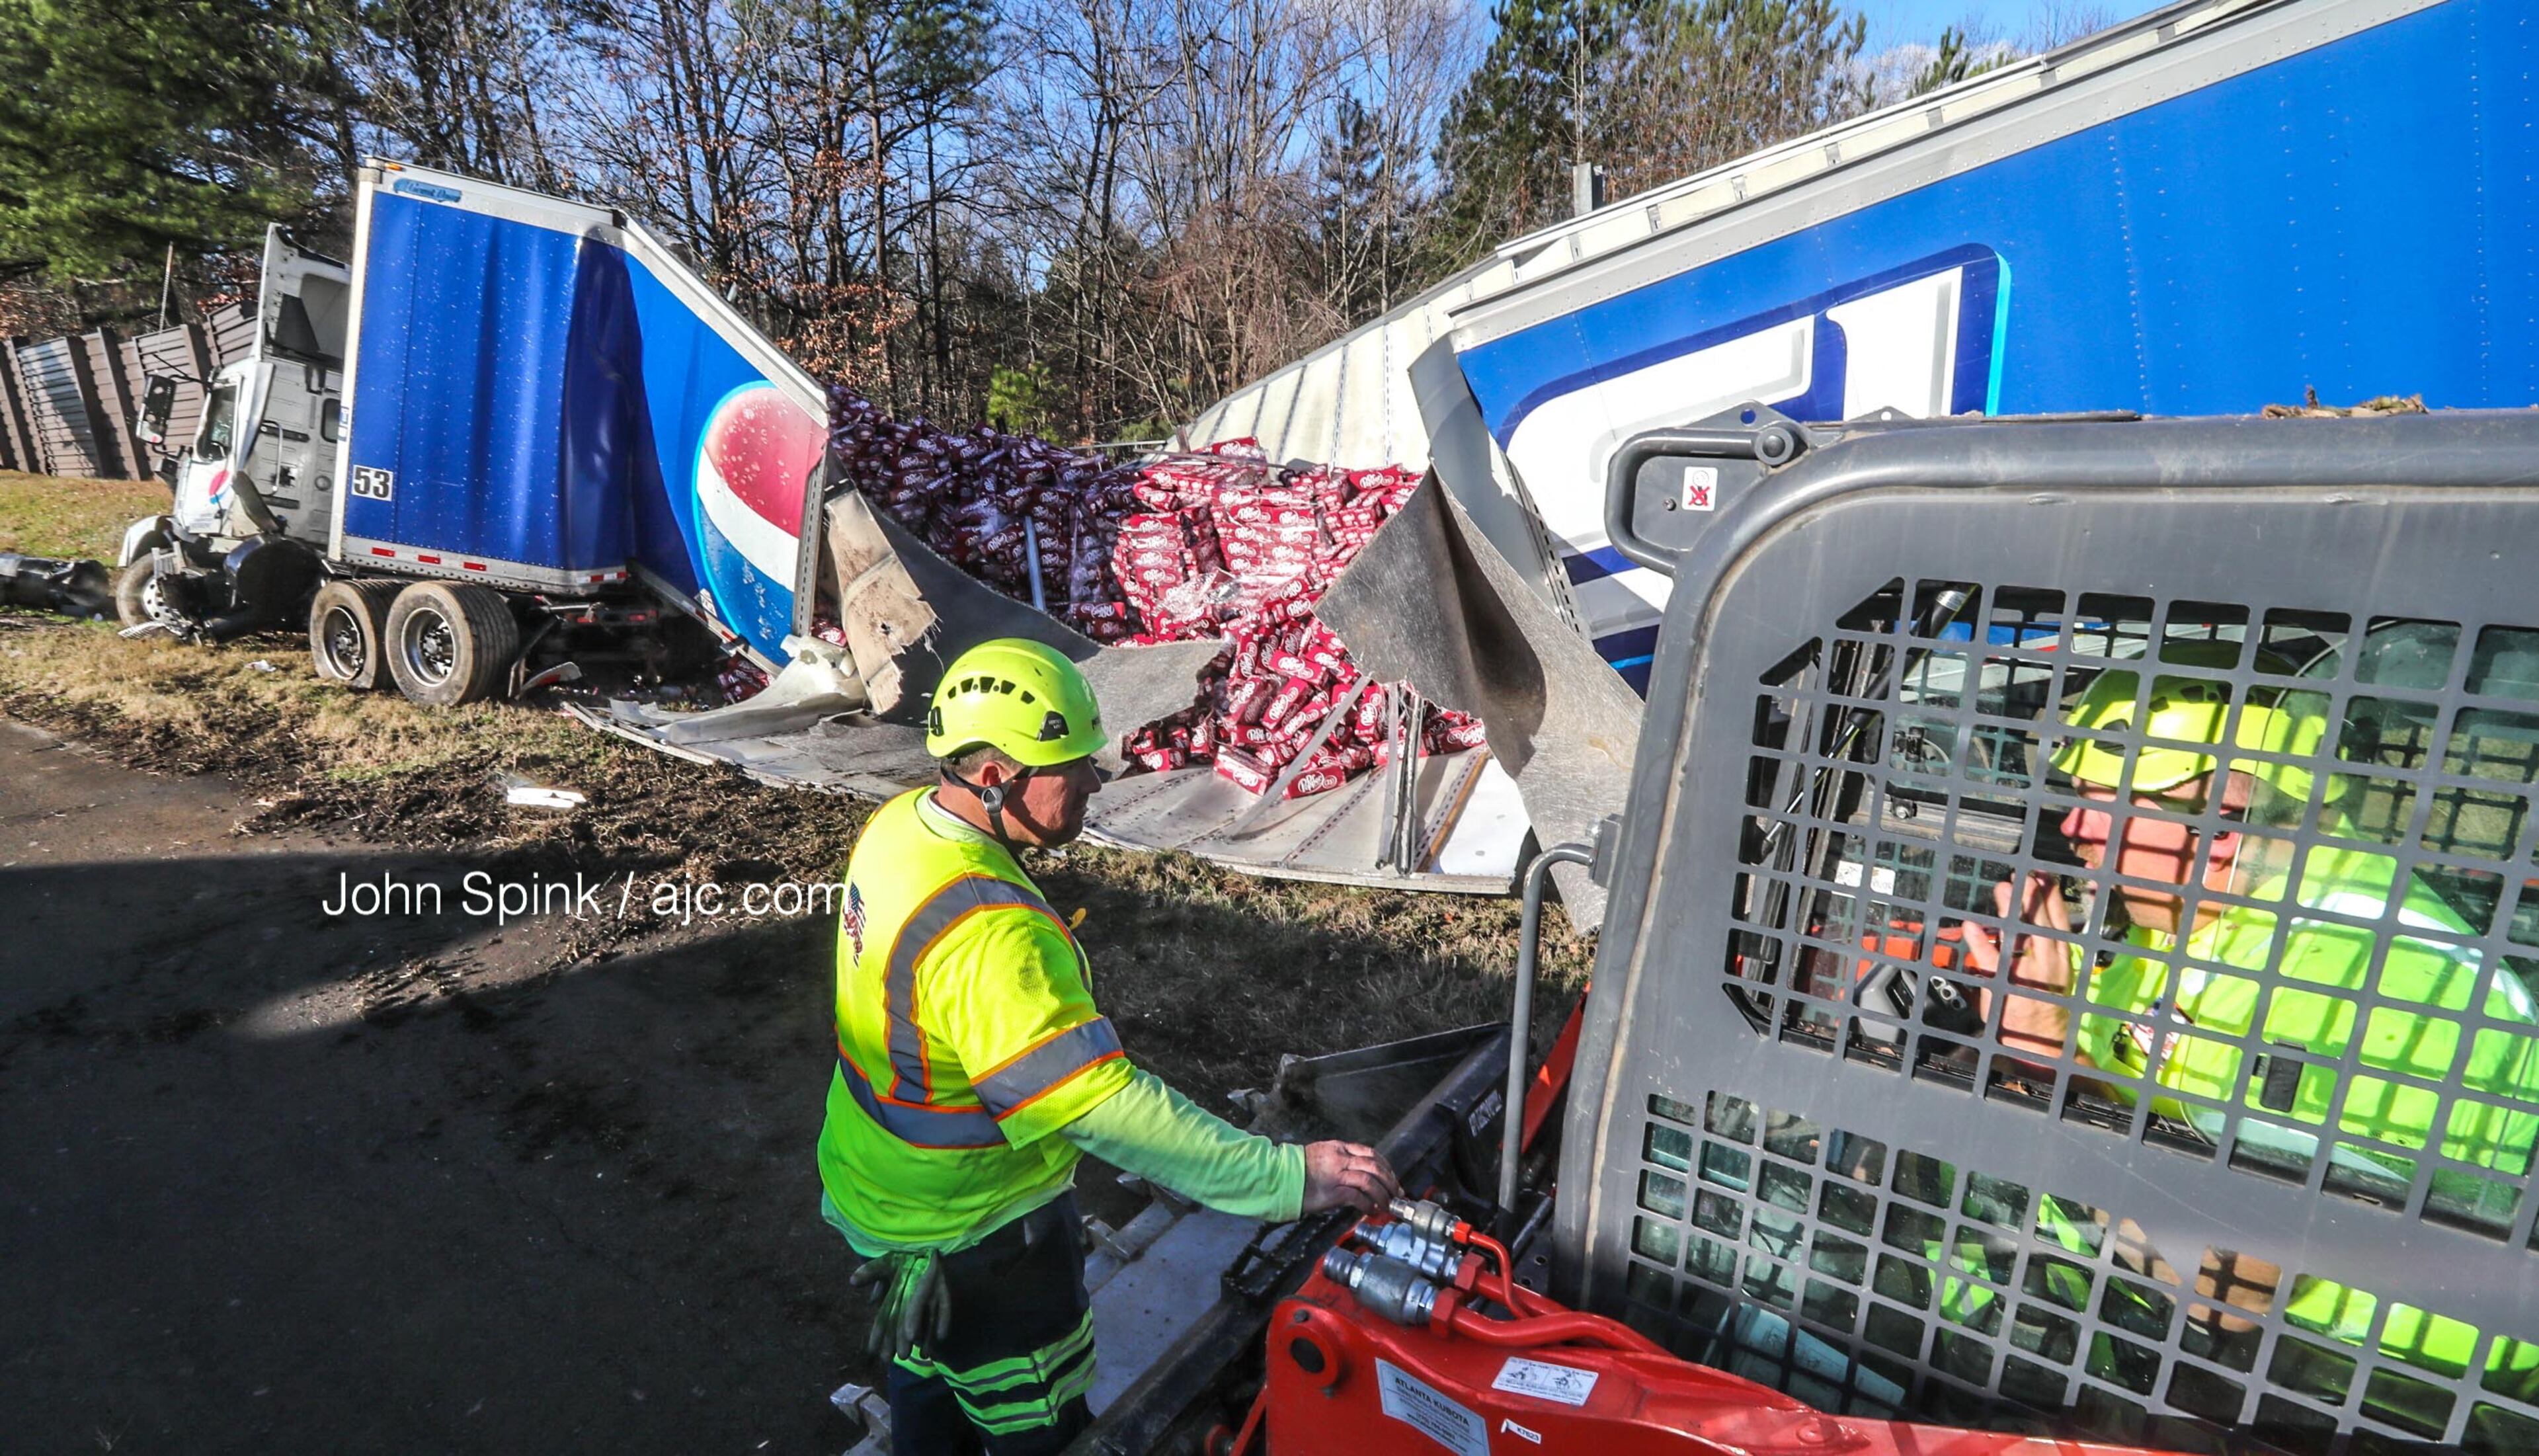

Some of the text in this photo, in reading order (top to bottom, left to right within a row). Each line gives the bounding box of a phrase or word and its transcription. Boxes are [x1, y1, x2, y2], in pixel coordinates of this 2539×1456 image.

[354, 467, 390, 498] 53
[1395, 1377, 1431, 1403] ATLANTA
[1433, 1399, 1470, 1426] KUBOTA
